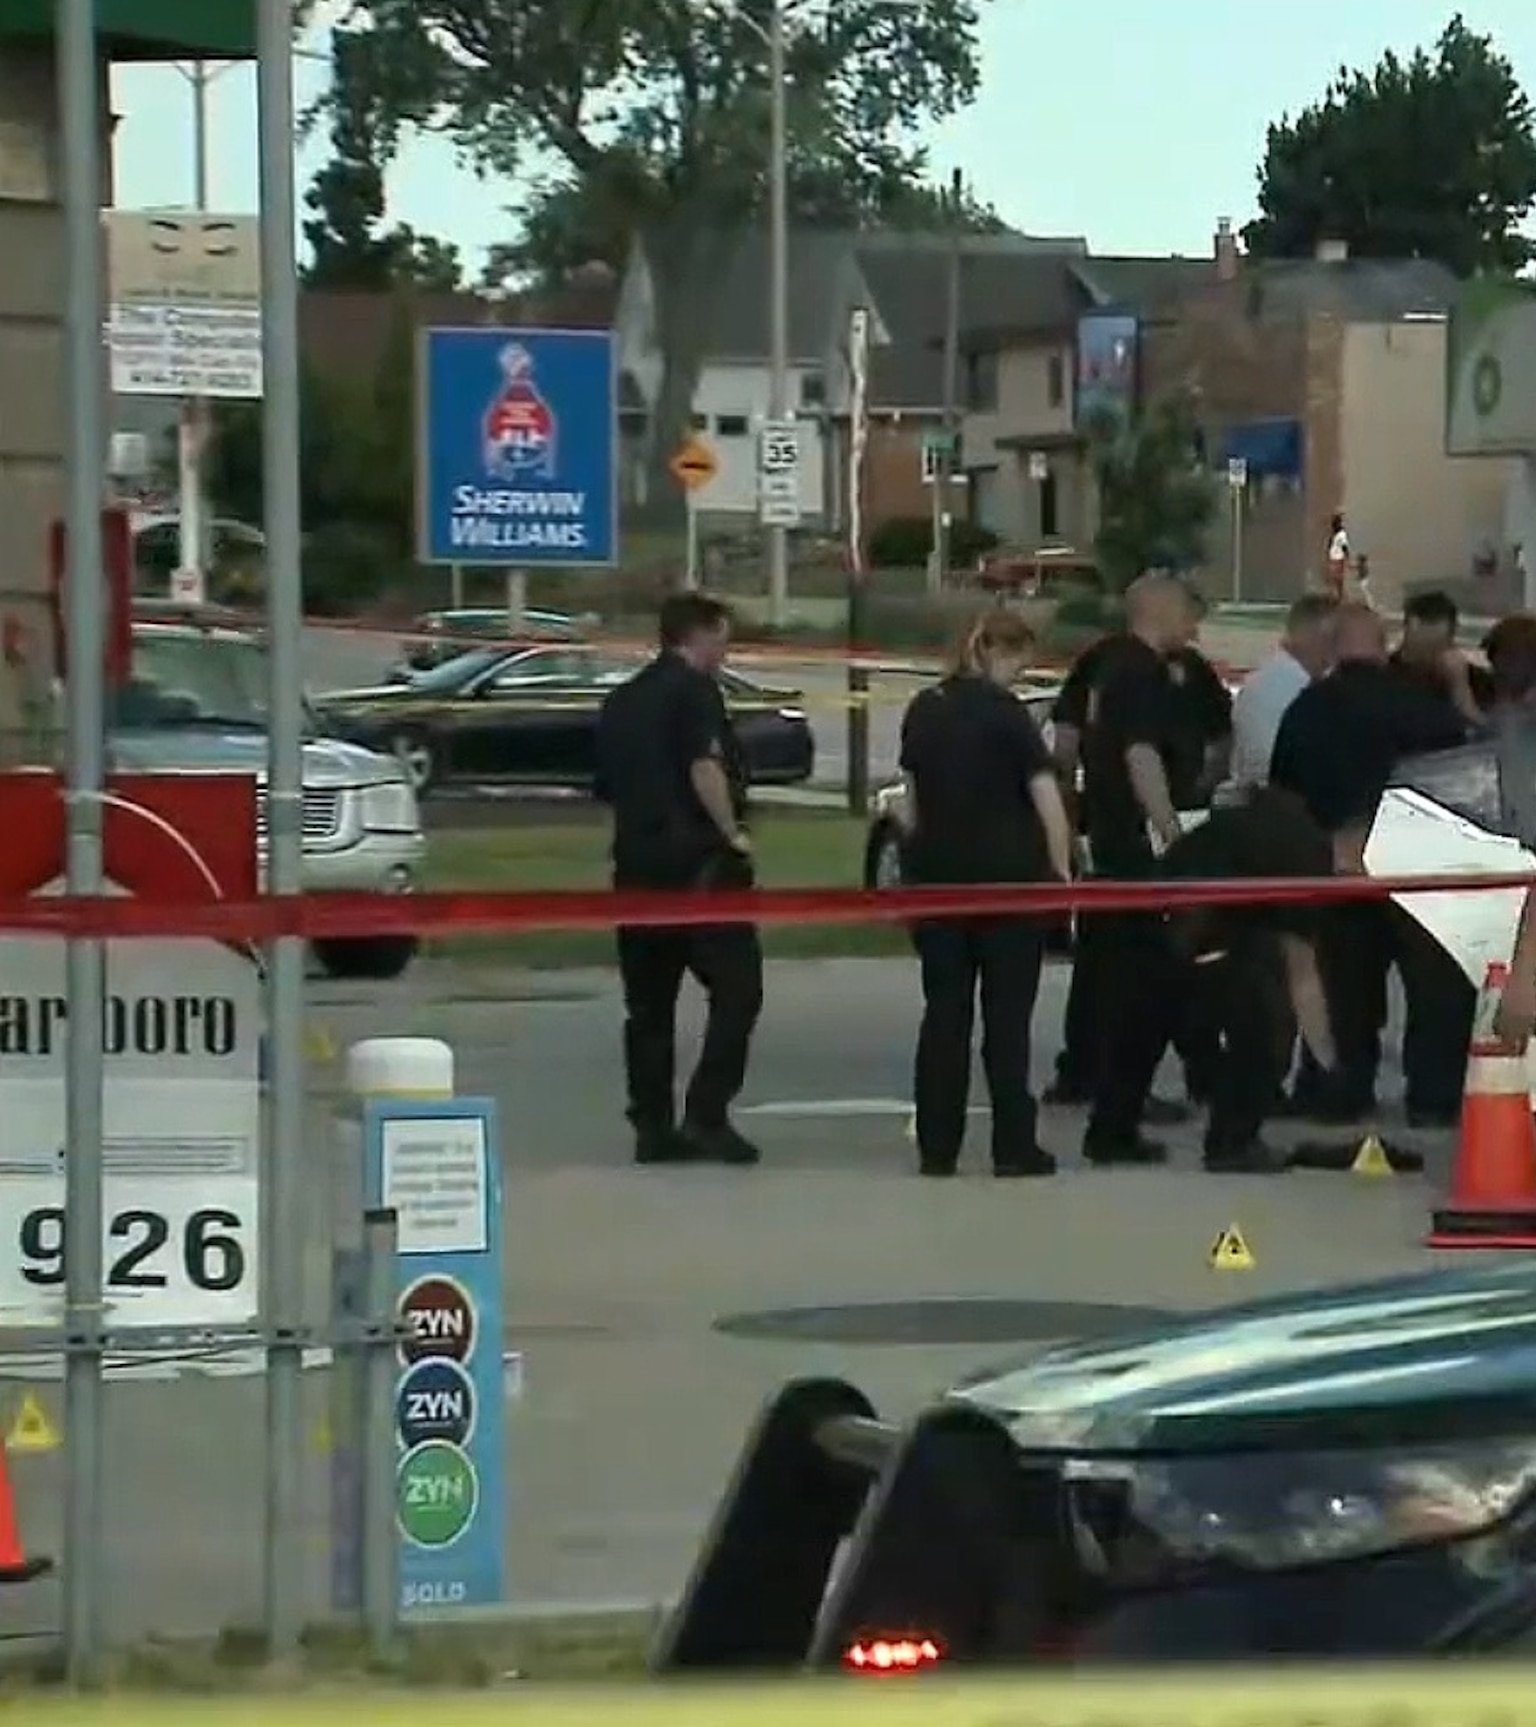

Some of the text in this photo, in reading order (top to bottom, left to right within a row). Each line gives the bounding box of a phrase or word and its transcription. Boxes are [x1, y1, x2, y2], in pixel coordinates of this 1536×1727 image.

[768, 443, 796, 462] 35
[452, 485, 585, 515] SHERWIN
[451, 517, 585, 548] WILLIAMS
[0, 996, 236, 1054] arboro
[408, 1309, 463, 1336] ZYN
[406, 1391, 463, 1419] ZYN
[405, 1474, 463, 1503] ZYN
